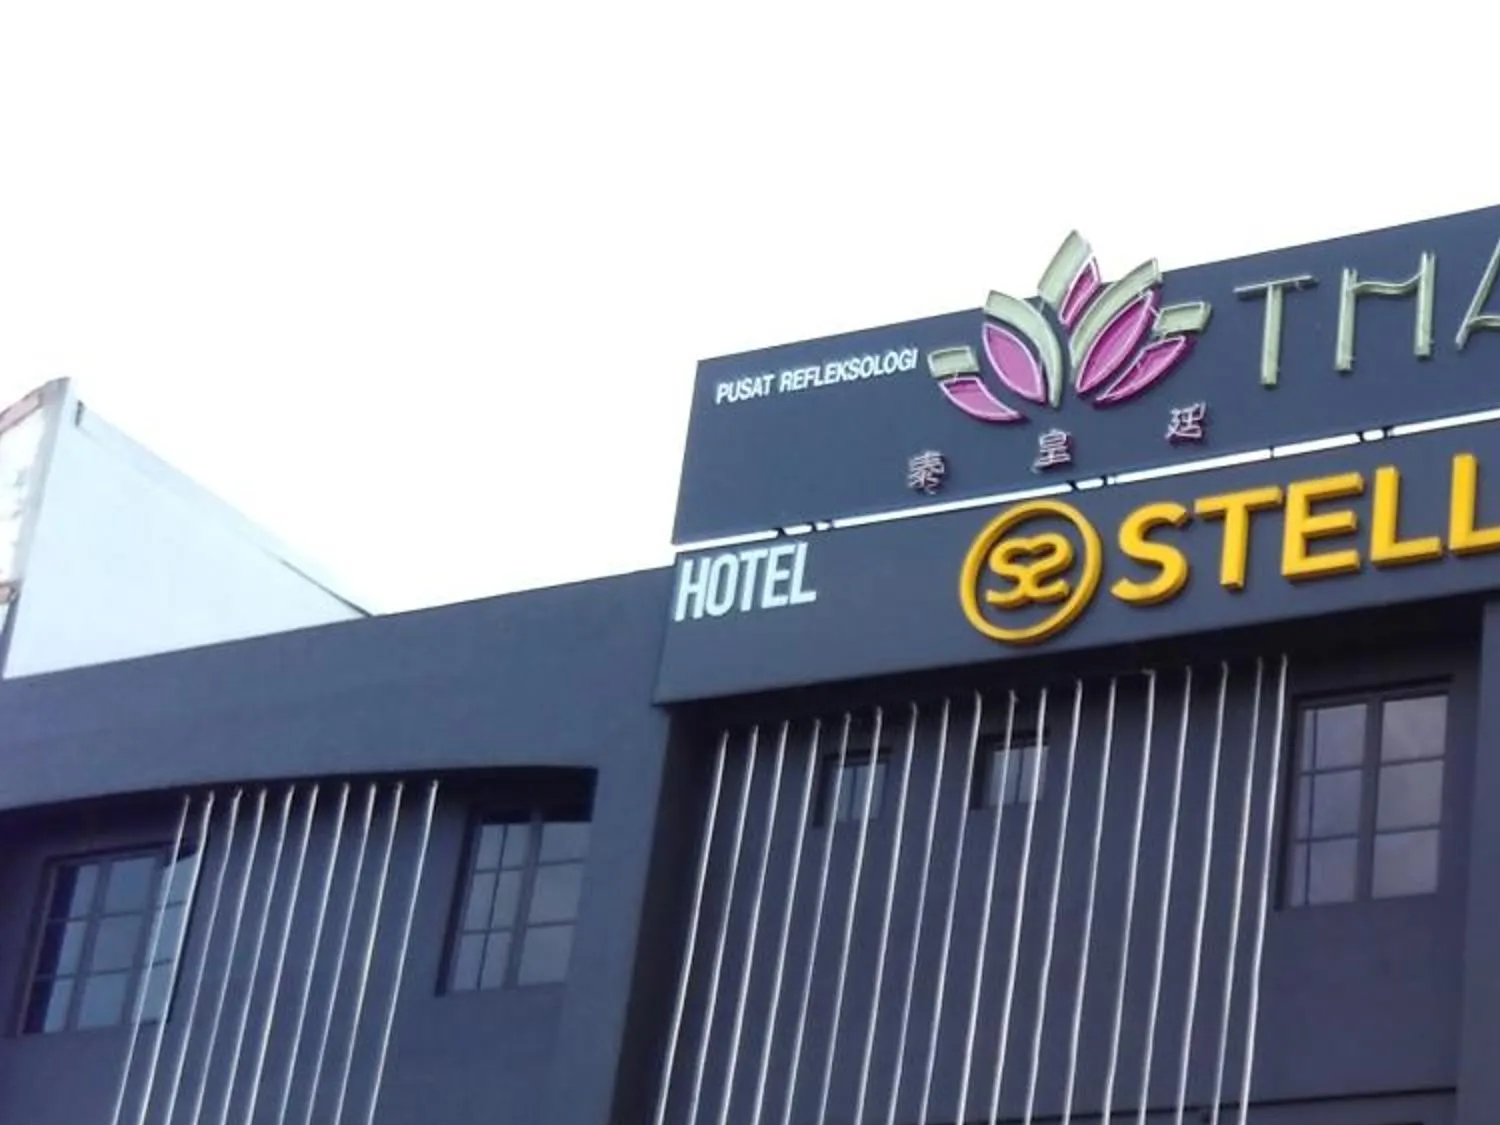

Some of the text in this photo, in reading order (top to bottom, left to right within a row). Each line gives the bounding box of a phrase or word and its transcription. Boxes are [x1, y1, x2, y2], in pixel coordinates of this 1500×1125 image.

[716, 348, 919, 405] PUSAT REFLEKSOLOGI
[674, 543, 817, 622] HOTEL
